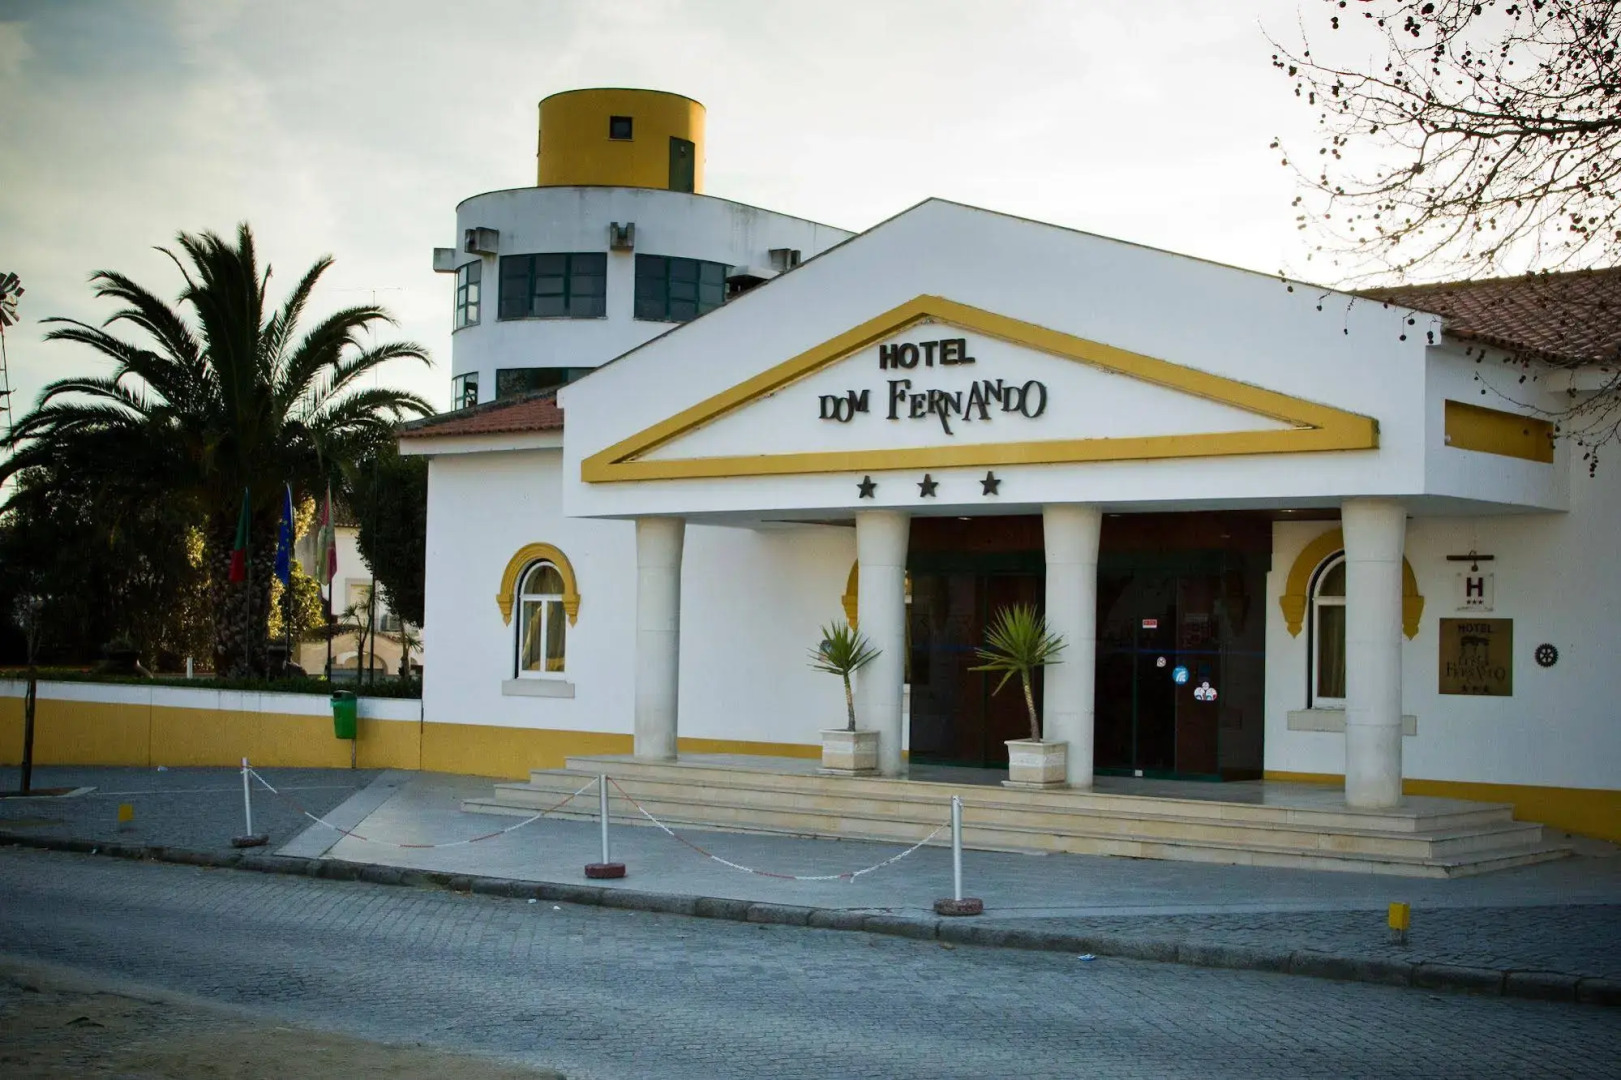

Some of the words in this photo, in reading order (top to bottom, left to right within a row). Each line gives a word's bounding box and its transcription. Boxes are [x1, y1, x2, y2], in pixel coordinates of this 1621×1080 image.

[879, 338, 975, 370] HOTEL
[818, 389, 870, 423] DOM
[887, 378, 1047, 436] FERNANDO
[1466, 577, 1484, 597] H
[1458, 623, 1493, 633] HOTEL
